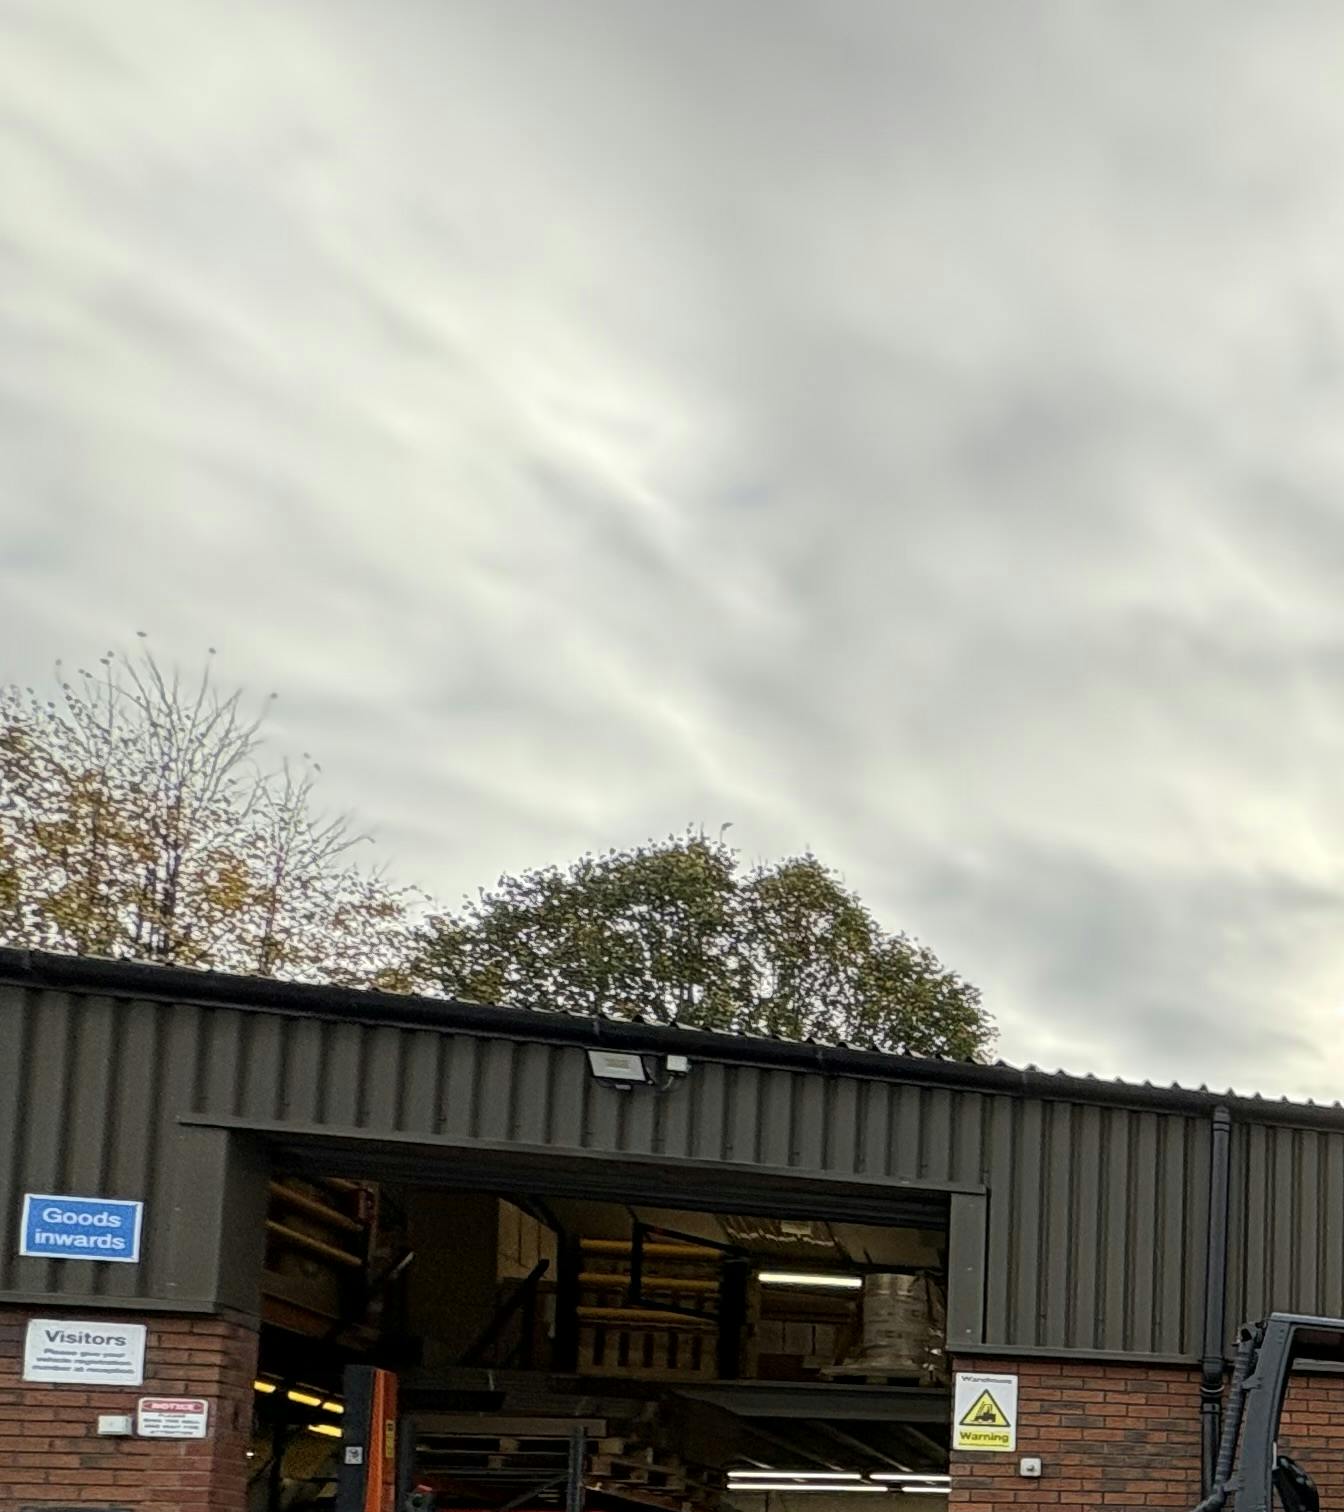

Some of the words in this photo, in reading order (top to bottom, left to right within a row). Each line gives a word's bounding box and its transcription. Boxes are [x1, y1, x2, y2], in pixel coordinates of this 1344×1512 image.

[42, 1207, 122, 1228] Goods
[34, 1228, 126, 1249] inwards
[44, 1329, 127, 1346] Visitors
[960, 1432, 1009, 1443] Warning
